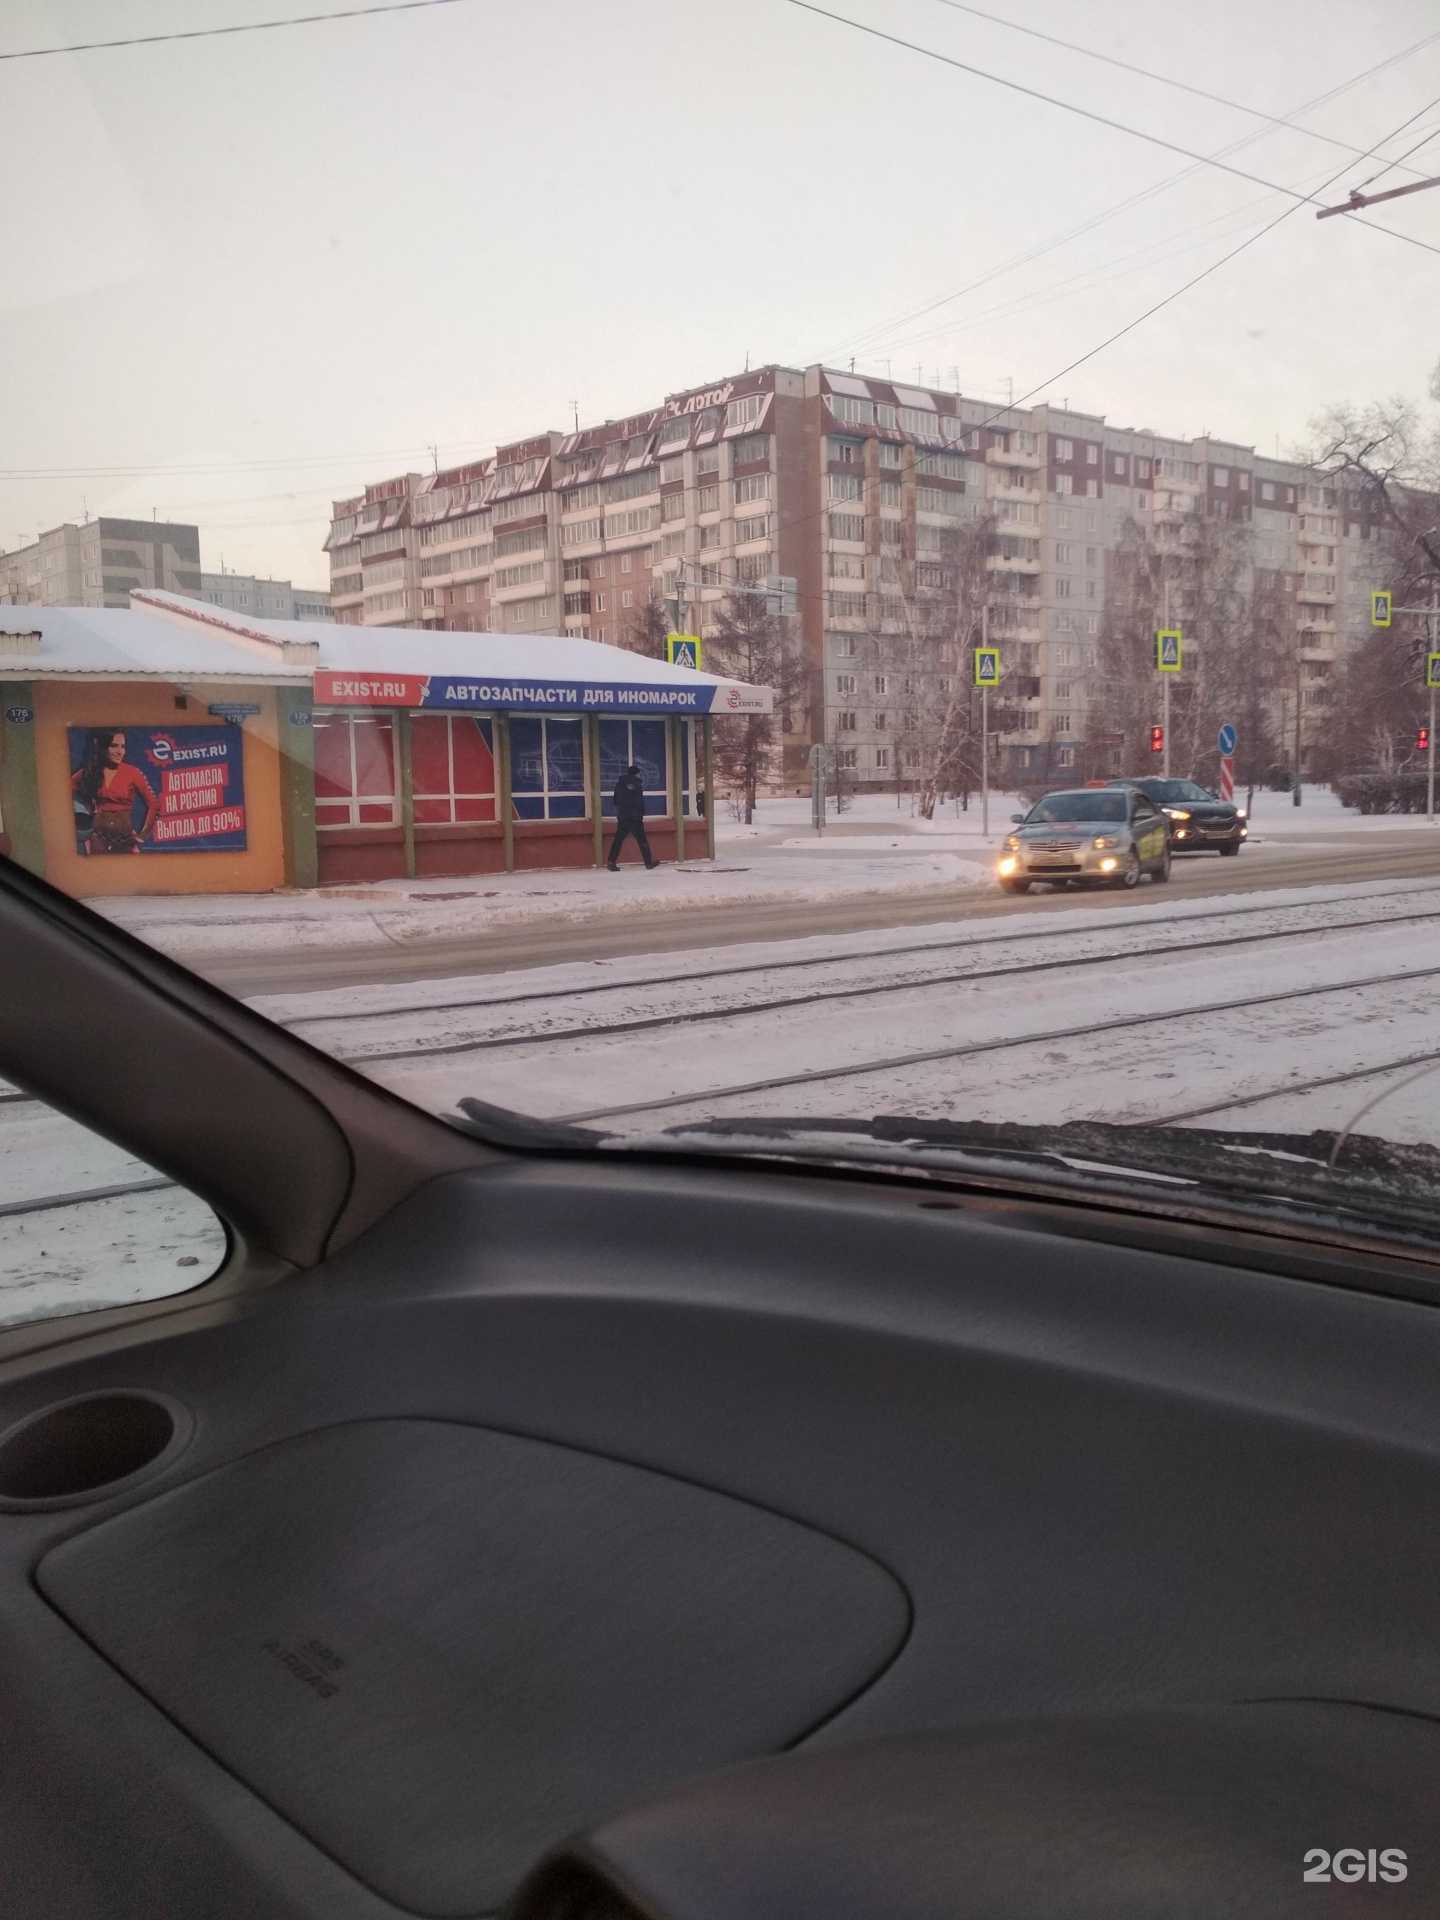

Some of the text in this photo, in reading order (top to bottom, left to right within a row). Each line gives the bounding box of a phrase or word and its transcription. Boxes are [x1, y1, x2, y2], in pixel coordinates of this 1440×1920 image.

[331, 680, 406, 698] EXIST.RU
[445, 685, 696, 705] АВТОЗАПЧАСТИ ДЛЯ ИНОМАРОК
[173, 744, 227, 761] EXIST.RU
[168, 767, 224, 792] АВТОМАСЛА
[165, 788, 217, 813] НА РОЗЛИВ
[156, 811, 240, 840] ВЫГОДА ДО 90%
